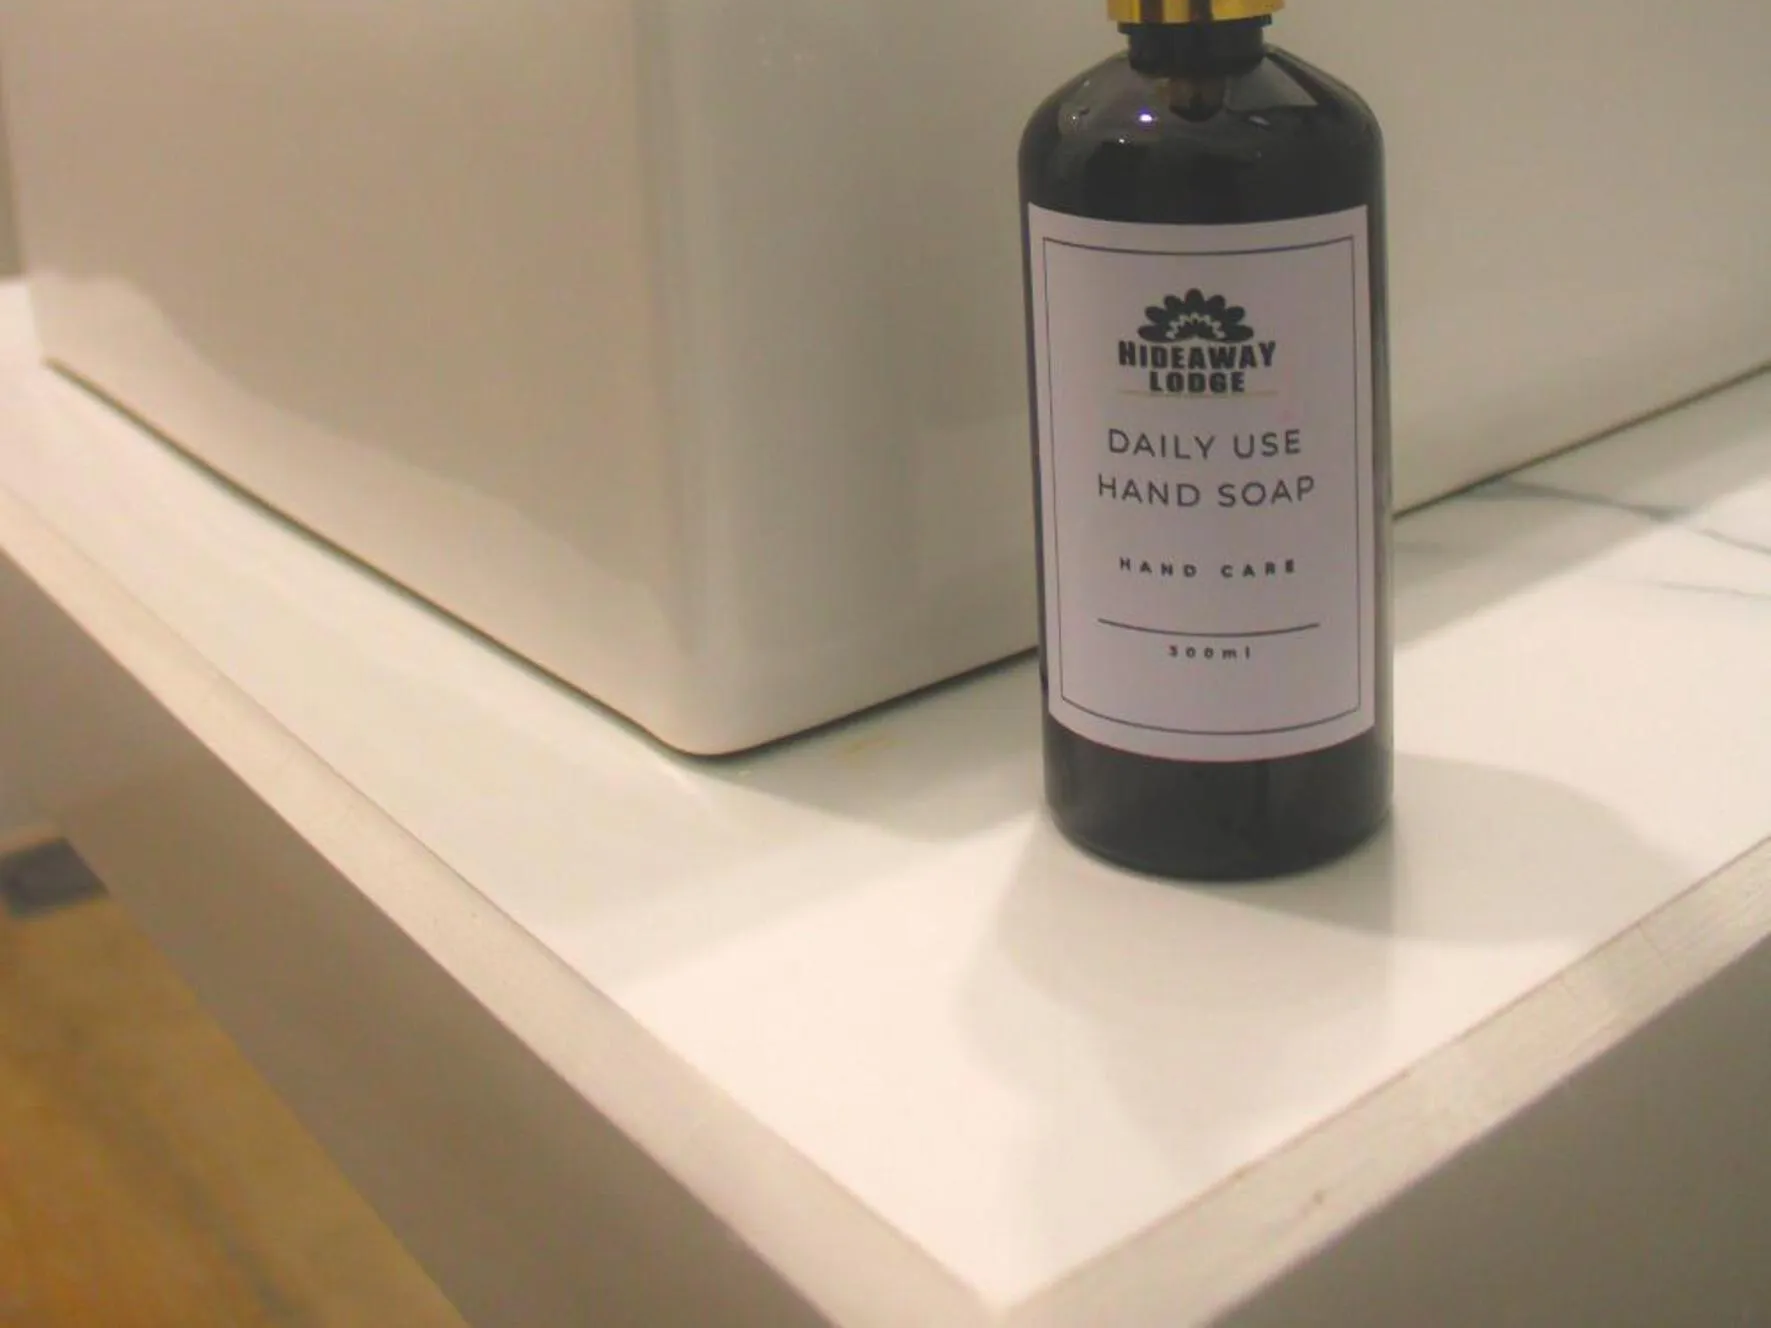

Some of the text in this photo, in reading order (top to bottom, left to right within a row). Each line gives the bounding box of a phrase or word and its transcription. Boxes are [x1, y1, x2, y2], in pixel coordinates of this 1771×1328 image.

[1118, 339, 1276, 370] HIDEAWAY
[1149, 371, 1245, 393] LODGE
[1108, 428, 1302, 460] DAILY USE
[1098, 473, 1315, 507] HAND SOAP
[1119, 557, 1296, 578] HAND CARE
